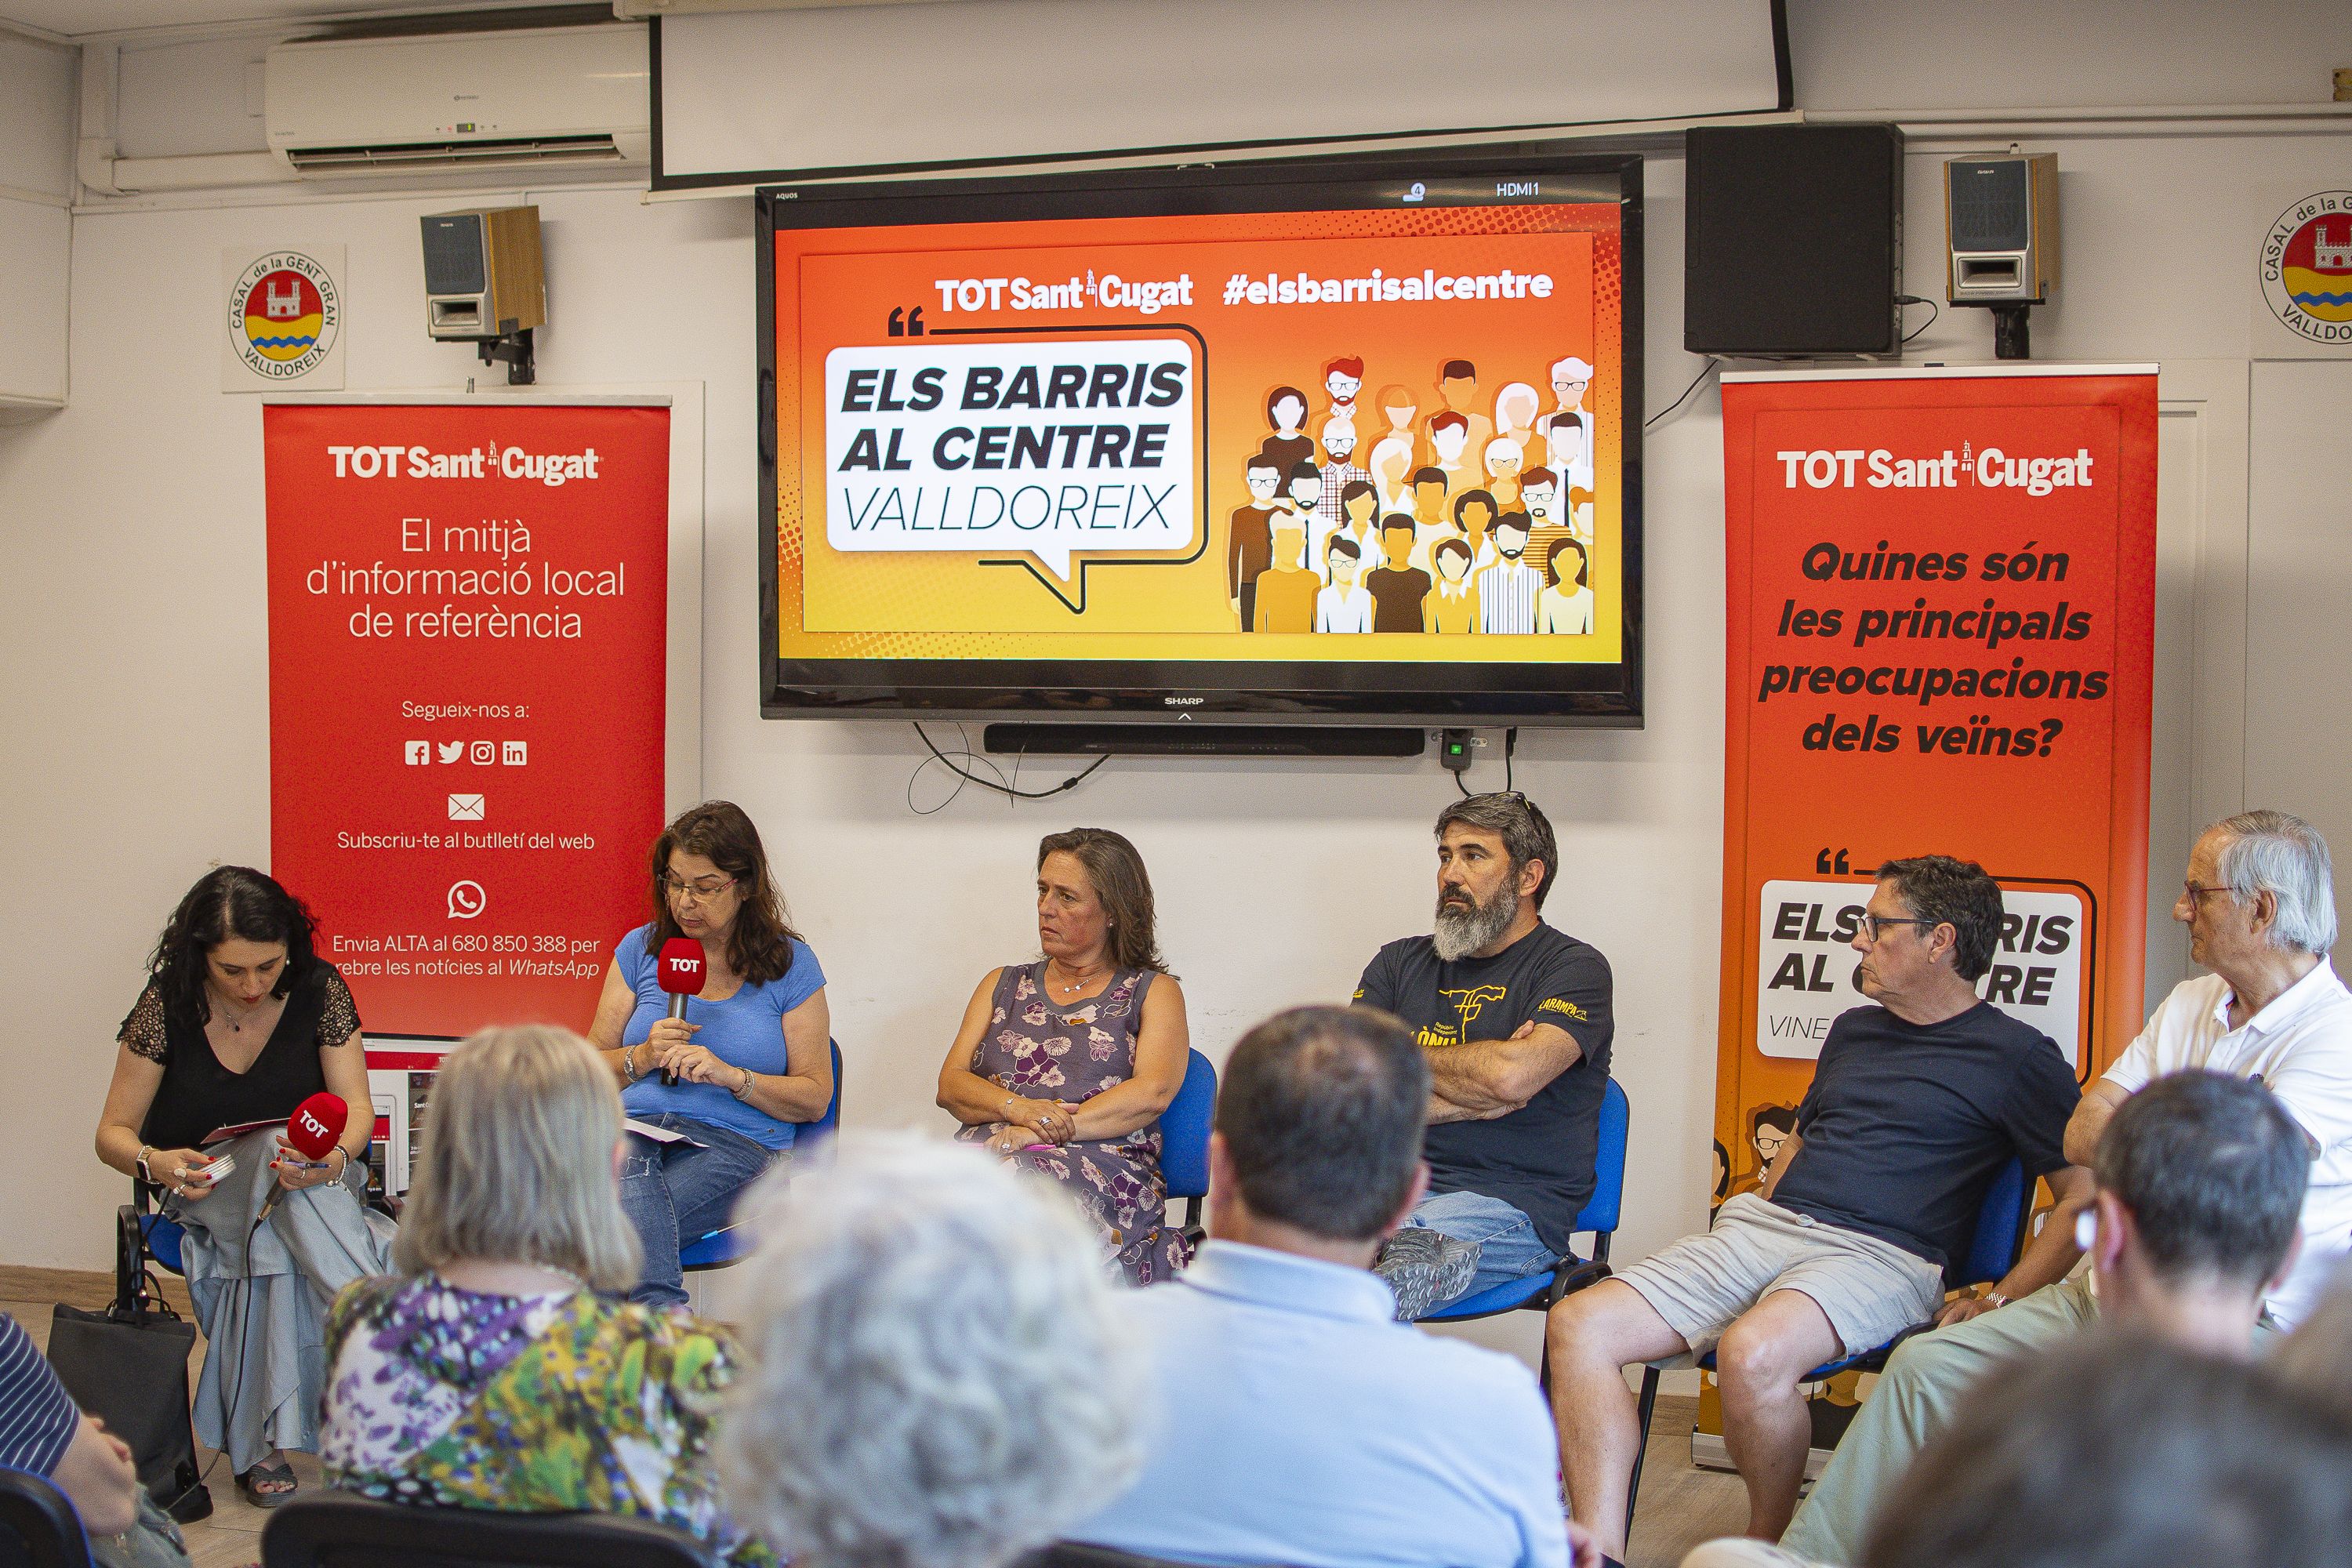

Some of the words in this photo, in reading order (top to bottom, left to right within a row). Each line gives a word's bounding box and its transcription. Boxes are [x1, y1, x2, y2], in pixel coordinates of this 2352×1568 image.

[1497, 182, 1539, 197] HDMI1
[2264, 223, 2295, 281] CASAL
[2296, 205, 2317, 221] de
[2321, 198, 2336, 211] la
[233, 280, 252, 328] CASAL
[253, 263, 267, 278] de
[271, 258, 281, 267] la
[286, 256, 321, 279] GENT
[319, 281, 336, 326] GRAN
[935, 278, 1008, 312] TOT
[1010, 276, 1083, 311] Sant
[1099, 273, 1193, 314] Cugat
[1223, 267, 1554, 306] #elsbarrisalcentre
[2282, 303, 2352, 340] VALLDO
[244, 344, 325, 376] VALLDOREIX
[841, 368, 947, 412] ELS
[960, 363, 1186, 410] BARRIS
[328, 446, 405, 477] TOT
[408, 446, 485, 477] Sant
[501, 447, 599, 486] Cugat
[837, 428, 912, 471] AL
[933, 424, 1170, 470] CENTRE
[1777, 450, 1864, 488] TOT
[1867, 449, 1958, 488] Sant
[1977, 448, 2092, 496] Cugat
[845, 485, 1177, 530] VALLDOREIX
[403, 518, 430, 551] El
[445, 518, 531, 561] mitjà
[545, 562, 623, 595] local
[1802, 540, 1969, 581] Quines
[1980, 541, 2069, 582] són
[350, 604, 393, 637] de
[407, 604, 581, 637] referència
[1778, 600, 1843, 637] les
[1854, 598, 2092, 649] principals
[1758, 657, 2109, 706] preocupacions
[402, 701, 510, 720] Segueix-nos
[515, 706, 528, 717] a:
[1165, 697, 1204, 706] SHARP
[1802, 713, 1901, 753] dels
[1918, 715, 2063, 757] veïns?
[338, 832, 439, 848] Subscriu-te
[445, 833, 458, 848] al
[465, 833, 524, 848] butlletí
[528, 833, 554, 848] del
[559, 833, 594, 849] web
[334, 935, 379, 951] Envia
[384, 935, 429, 951] ALTA
[434, 936, 447, 951] al
[452, 935, 488, 951] 680
[492, 935, 527, 952] 850
[532, 936, 566, 952] 388
[572, 941, 600, 956] per
[1772, 902, 1867, 943] ELS
[1998, 913, 2075, 955] RIS
[335, 959, 383, 976] rebre
[387, 960, 410, 975] les
[416, 959, 483, 975] notícies
[488, 960, 501, 975] al
[510, 960, 599, 979] WhatsApp
[670, 958, 699, 972] TOT
[1767, 953, 1834, 992] AL
[1769, 1015, 1830, 1040] VINE
[299, 1109, 328, 1138] TOT
